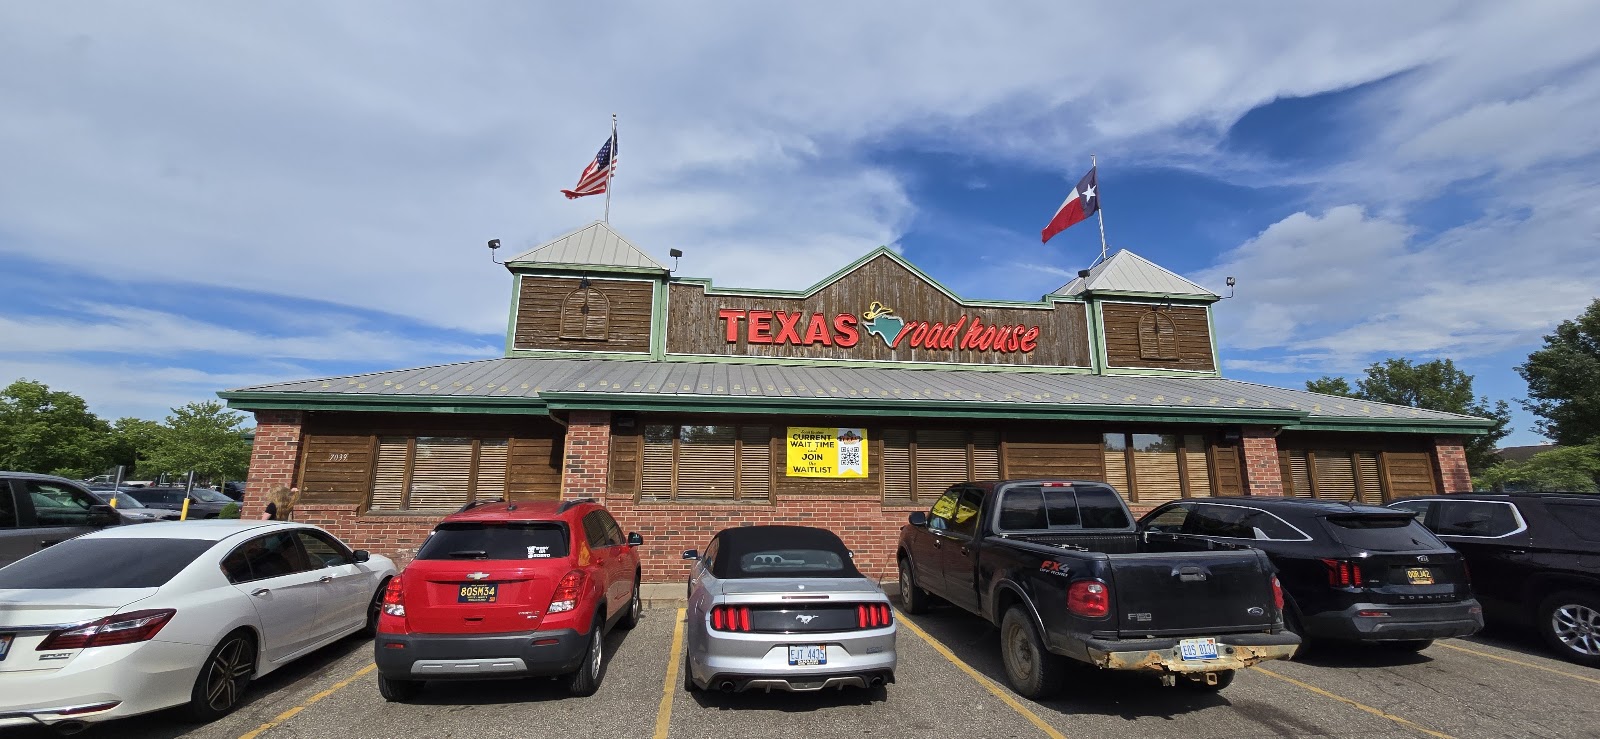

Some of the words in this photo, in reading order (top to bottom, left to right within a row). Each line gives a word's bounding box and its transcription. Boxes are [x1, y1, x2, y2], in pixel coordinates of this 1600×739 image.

[719, 308, 859, 348] TEXAS
[801, 453, 823, 461] JOIN
[1041, 560, 1070, 573] FX4
